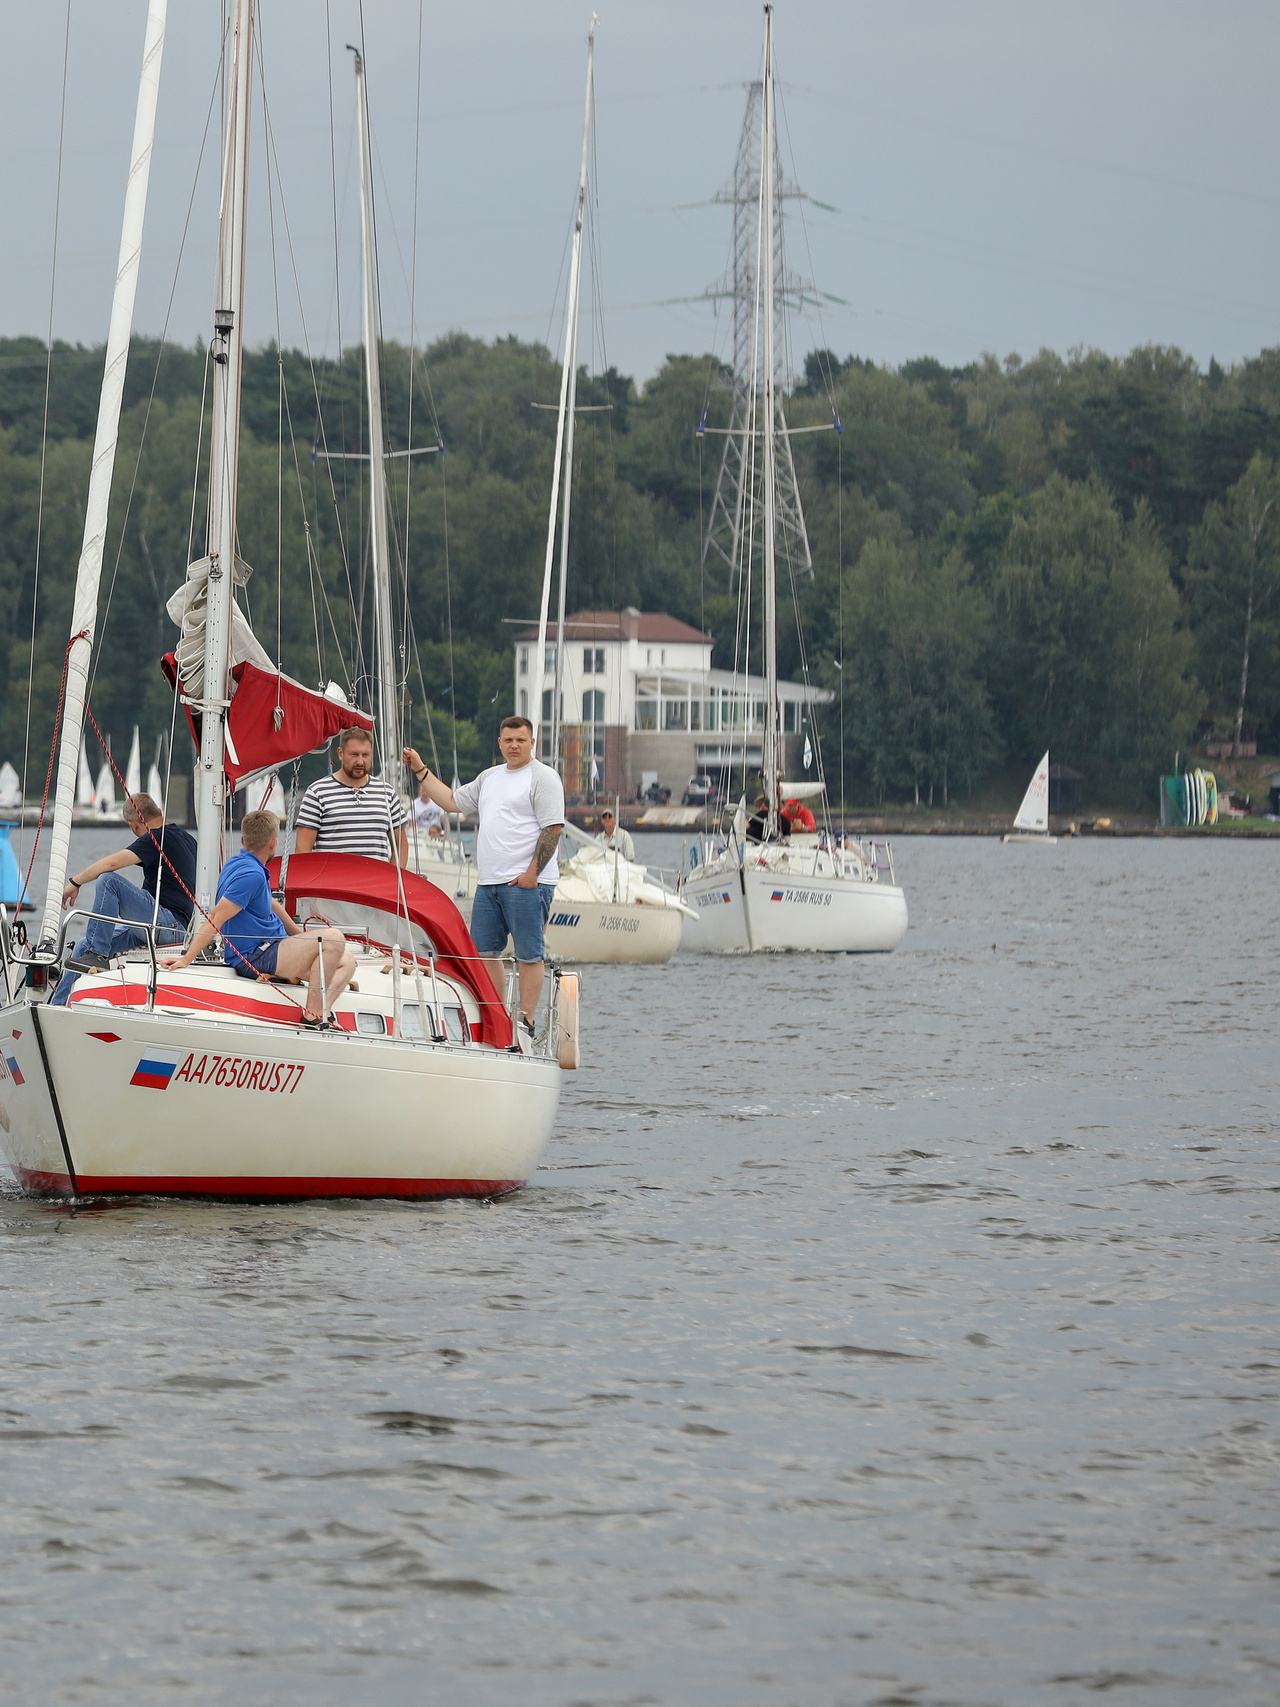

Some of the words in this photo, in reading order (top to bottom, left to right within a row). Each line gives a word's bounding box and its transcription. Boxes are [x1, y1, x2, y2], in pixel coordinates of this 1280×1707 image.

[808, 891, 824, 905] RUS
[548, 912, 581, 927] LOKKI
[174, 1053, 306, 1094] AA7650RUS77
